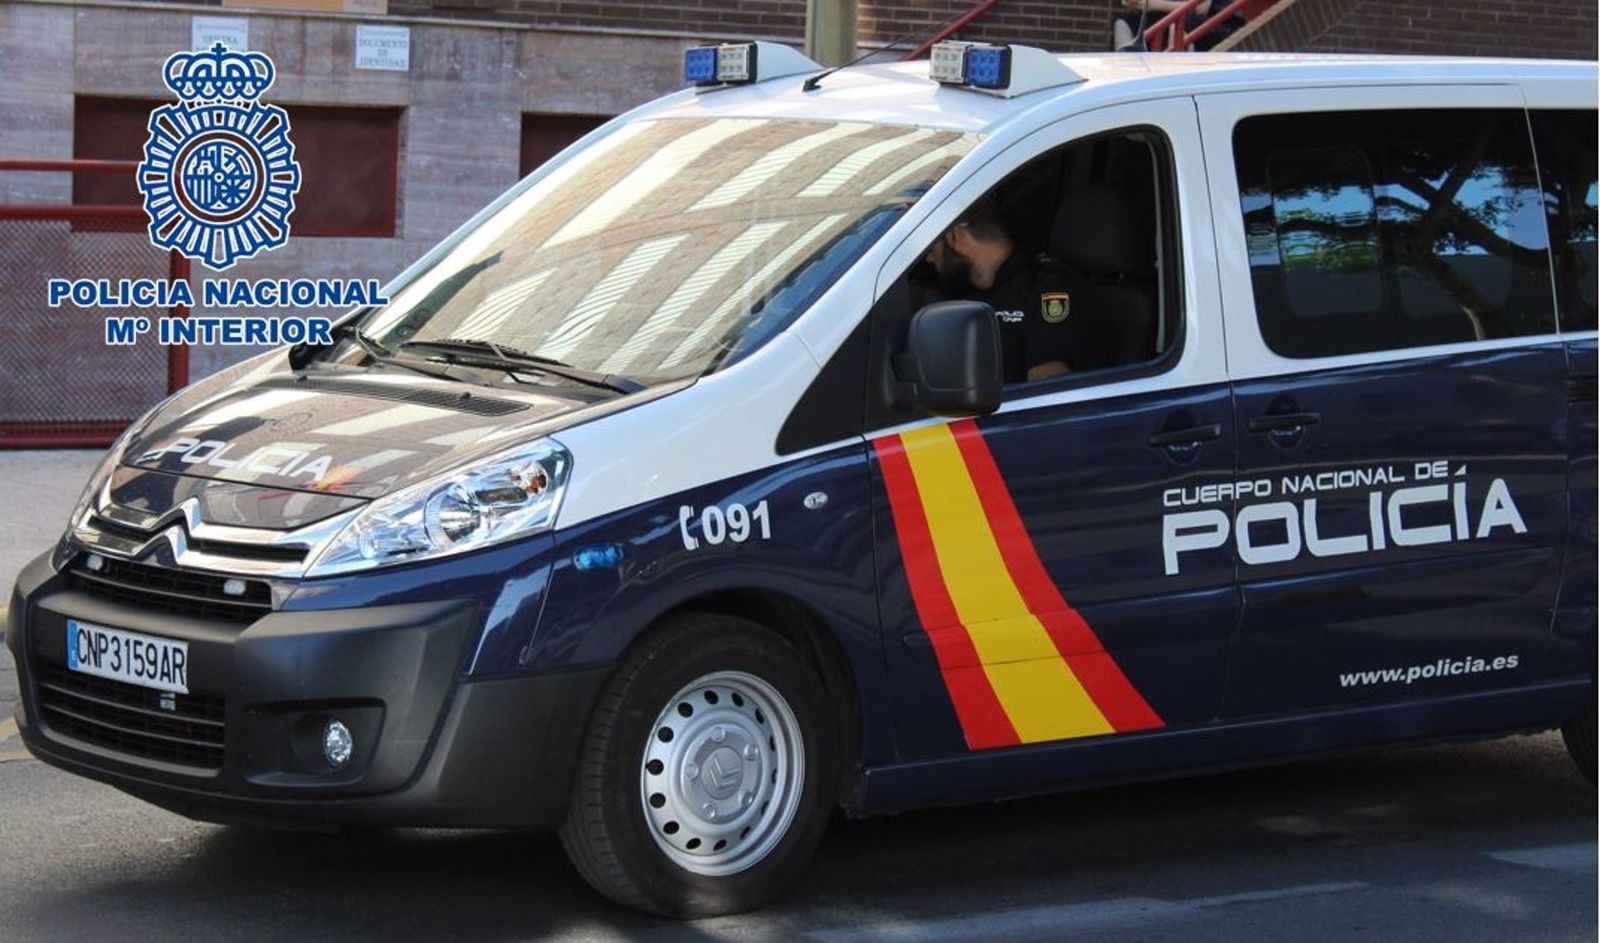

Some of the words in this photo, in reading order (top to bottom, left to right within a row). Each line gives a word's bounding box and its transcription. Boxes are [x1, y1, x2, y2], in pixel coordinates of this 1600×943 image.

[360, 38, 406, 48] DOCUMENTO
[1163, 479, 1272, 507] CUERPO
[1281, 466, 1406, 494] NACIONAL
[1414, 460, 1448, 480] DE
[701, 500, 772, 545] 091
[76, 629, 186, 685] CNP3159AR
[1339, 654, 1520, 685] www.policia.es
